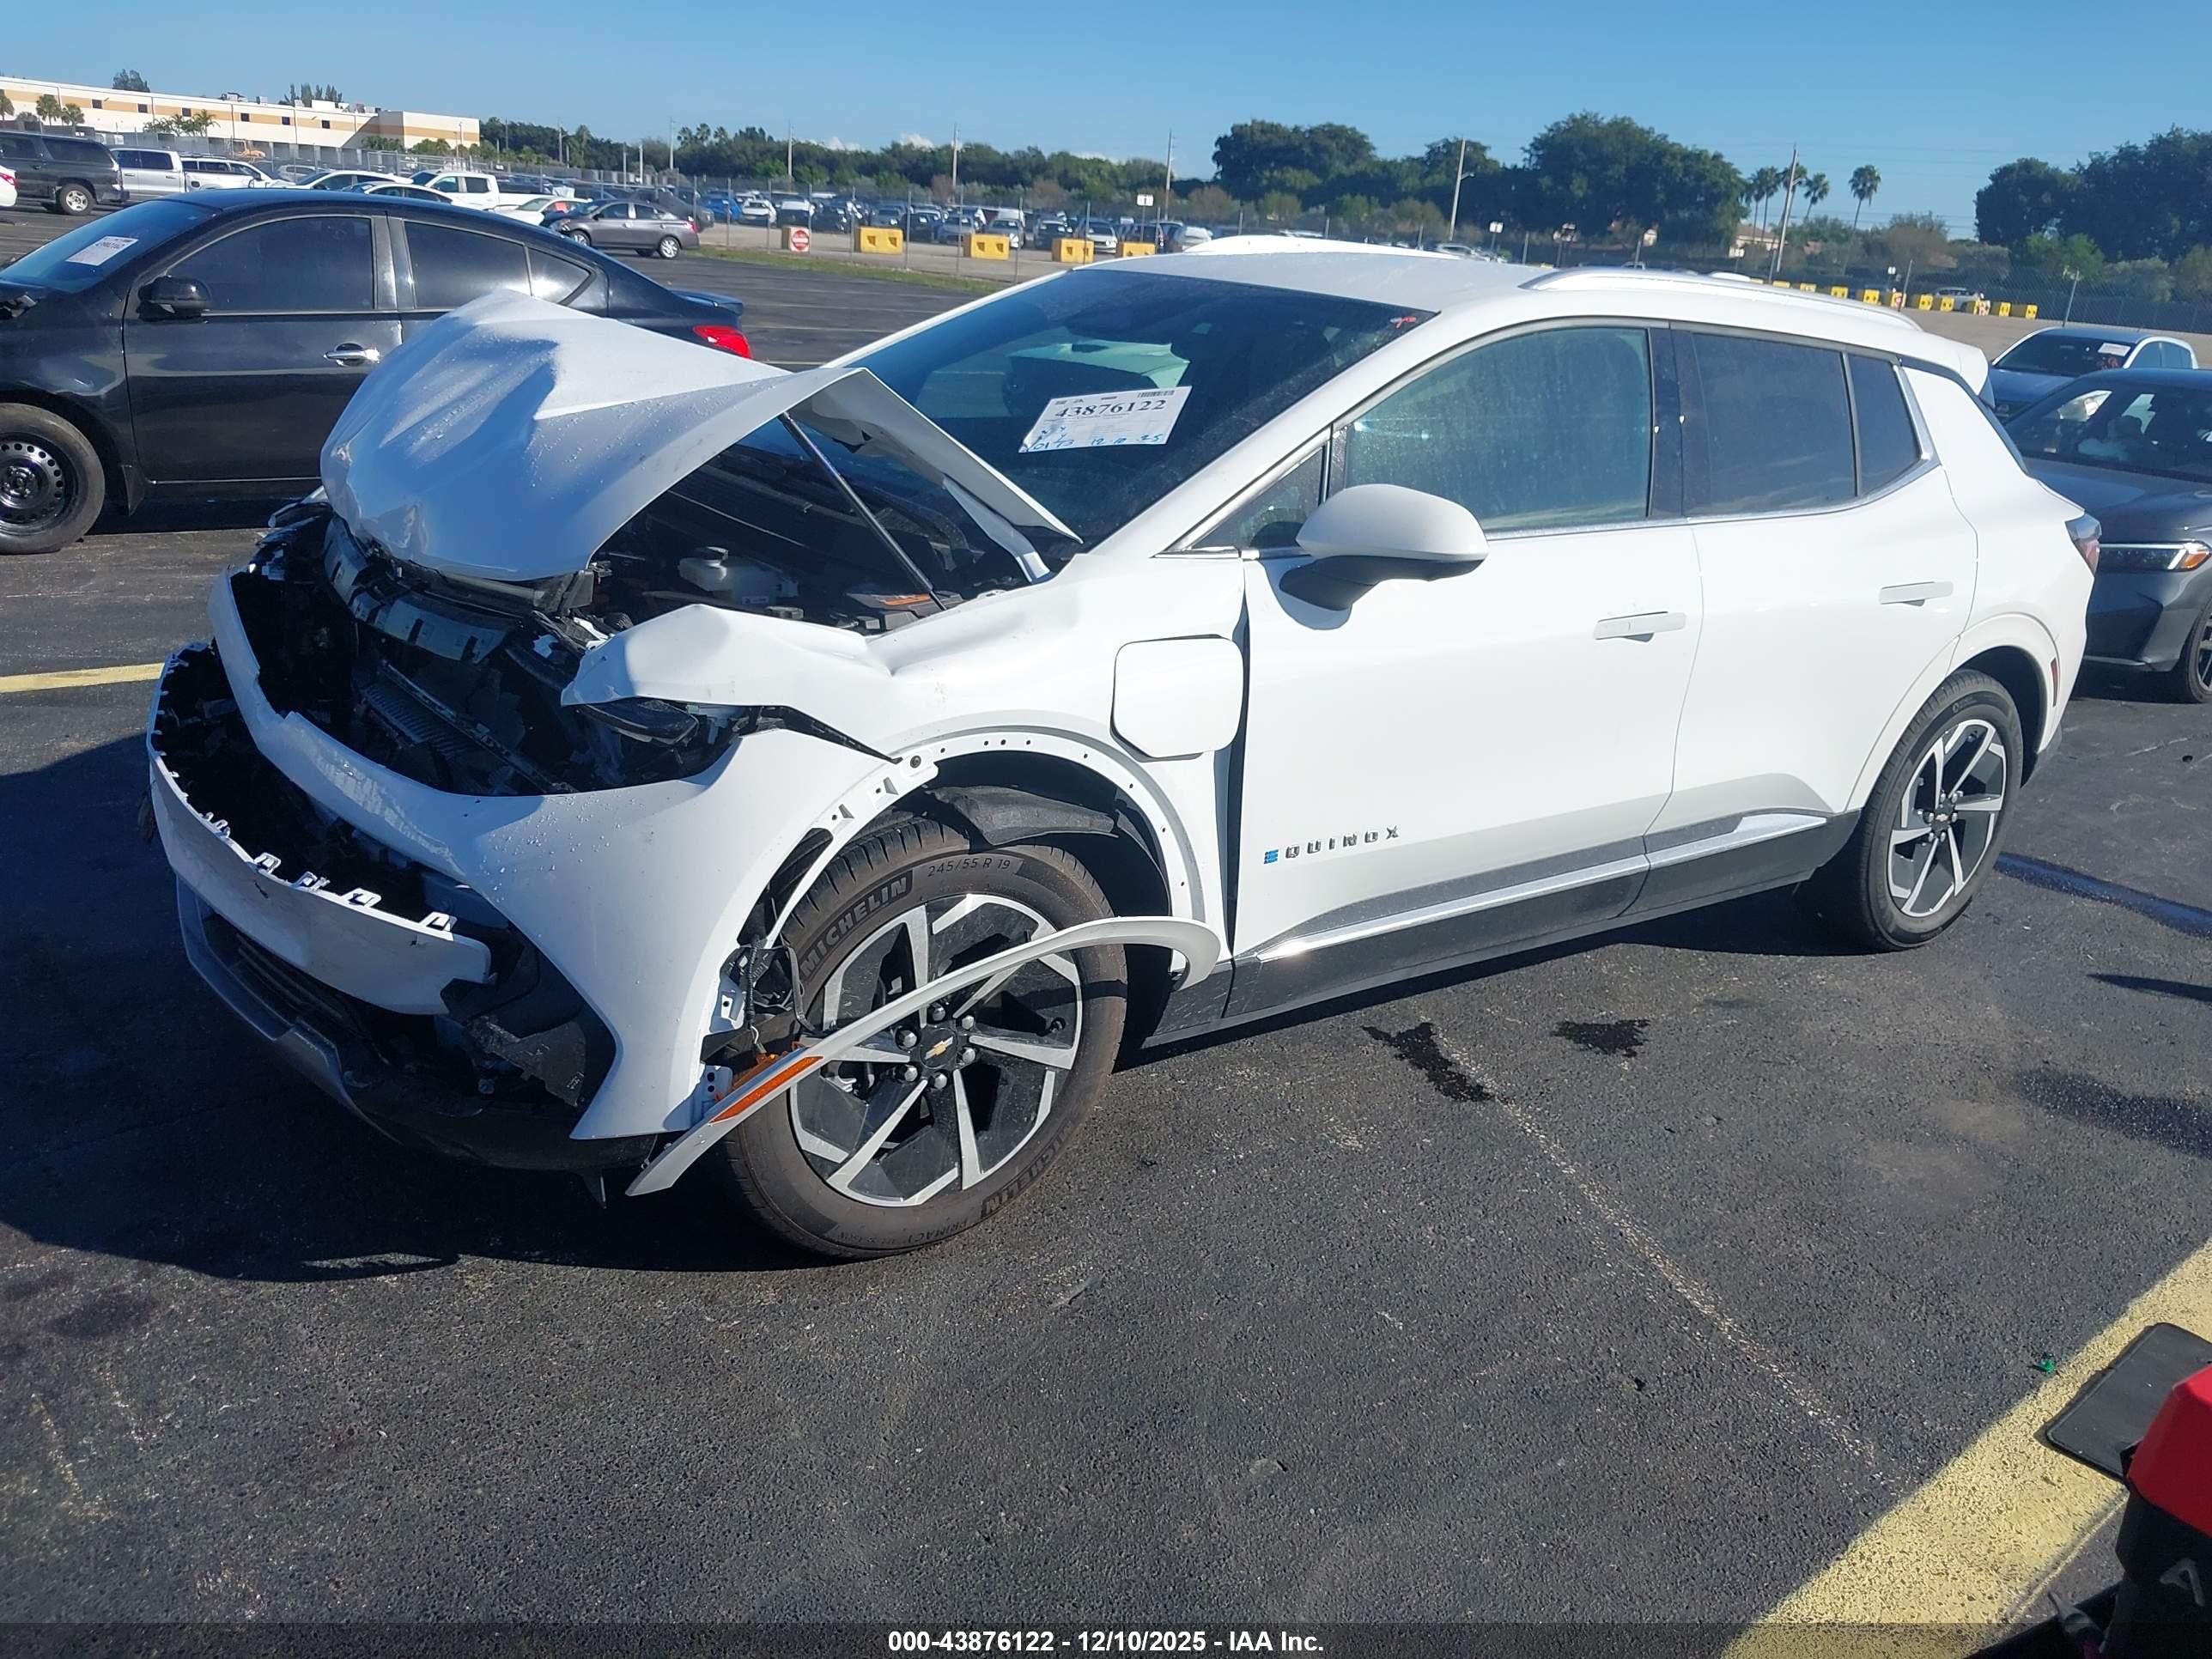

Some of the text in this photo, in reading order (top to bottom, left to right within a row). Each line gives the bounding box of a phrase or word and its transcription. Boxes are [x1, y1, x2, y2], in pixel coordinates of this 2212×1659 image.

[1054, 399, 1167, 417] 43876122
[1263, 825, 1400, 865] EQUINOX
[927, 857, 1011, 877] 245/55 R 19
[799, 877, 907, 978] MICHELIN
